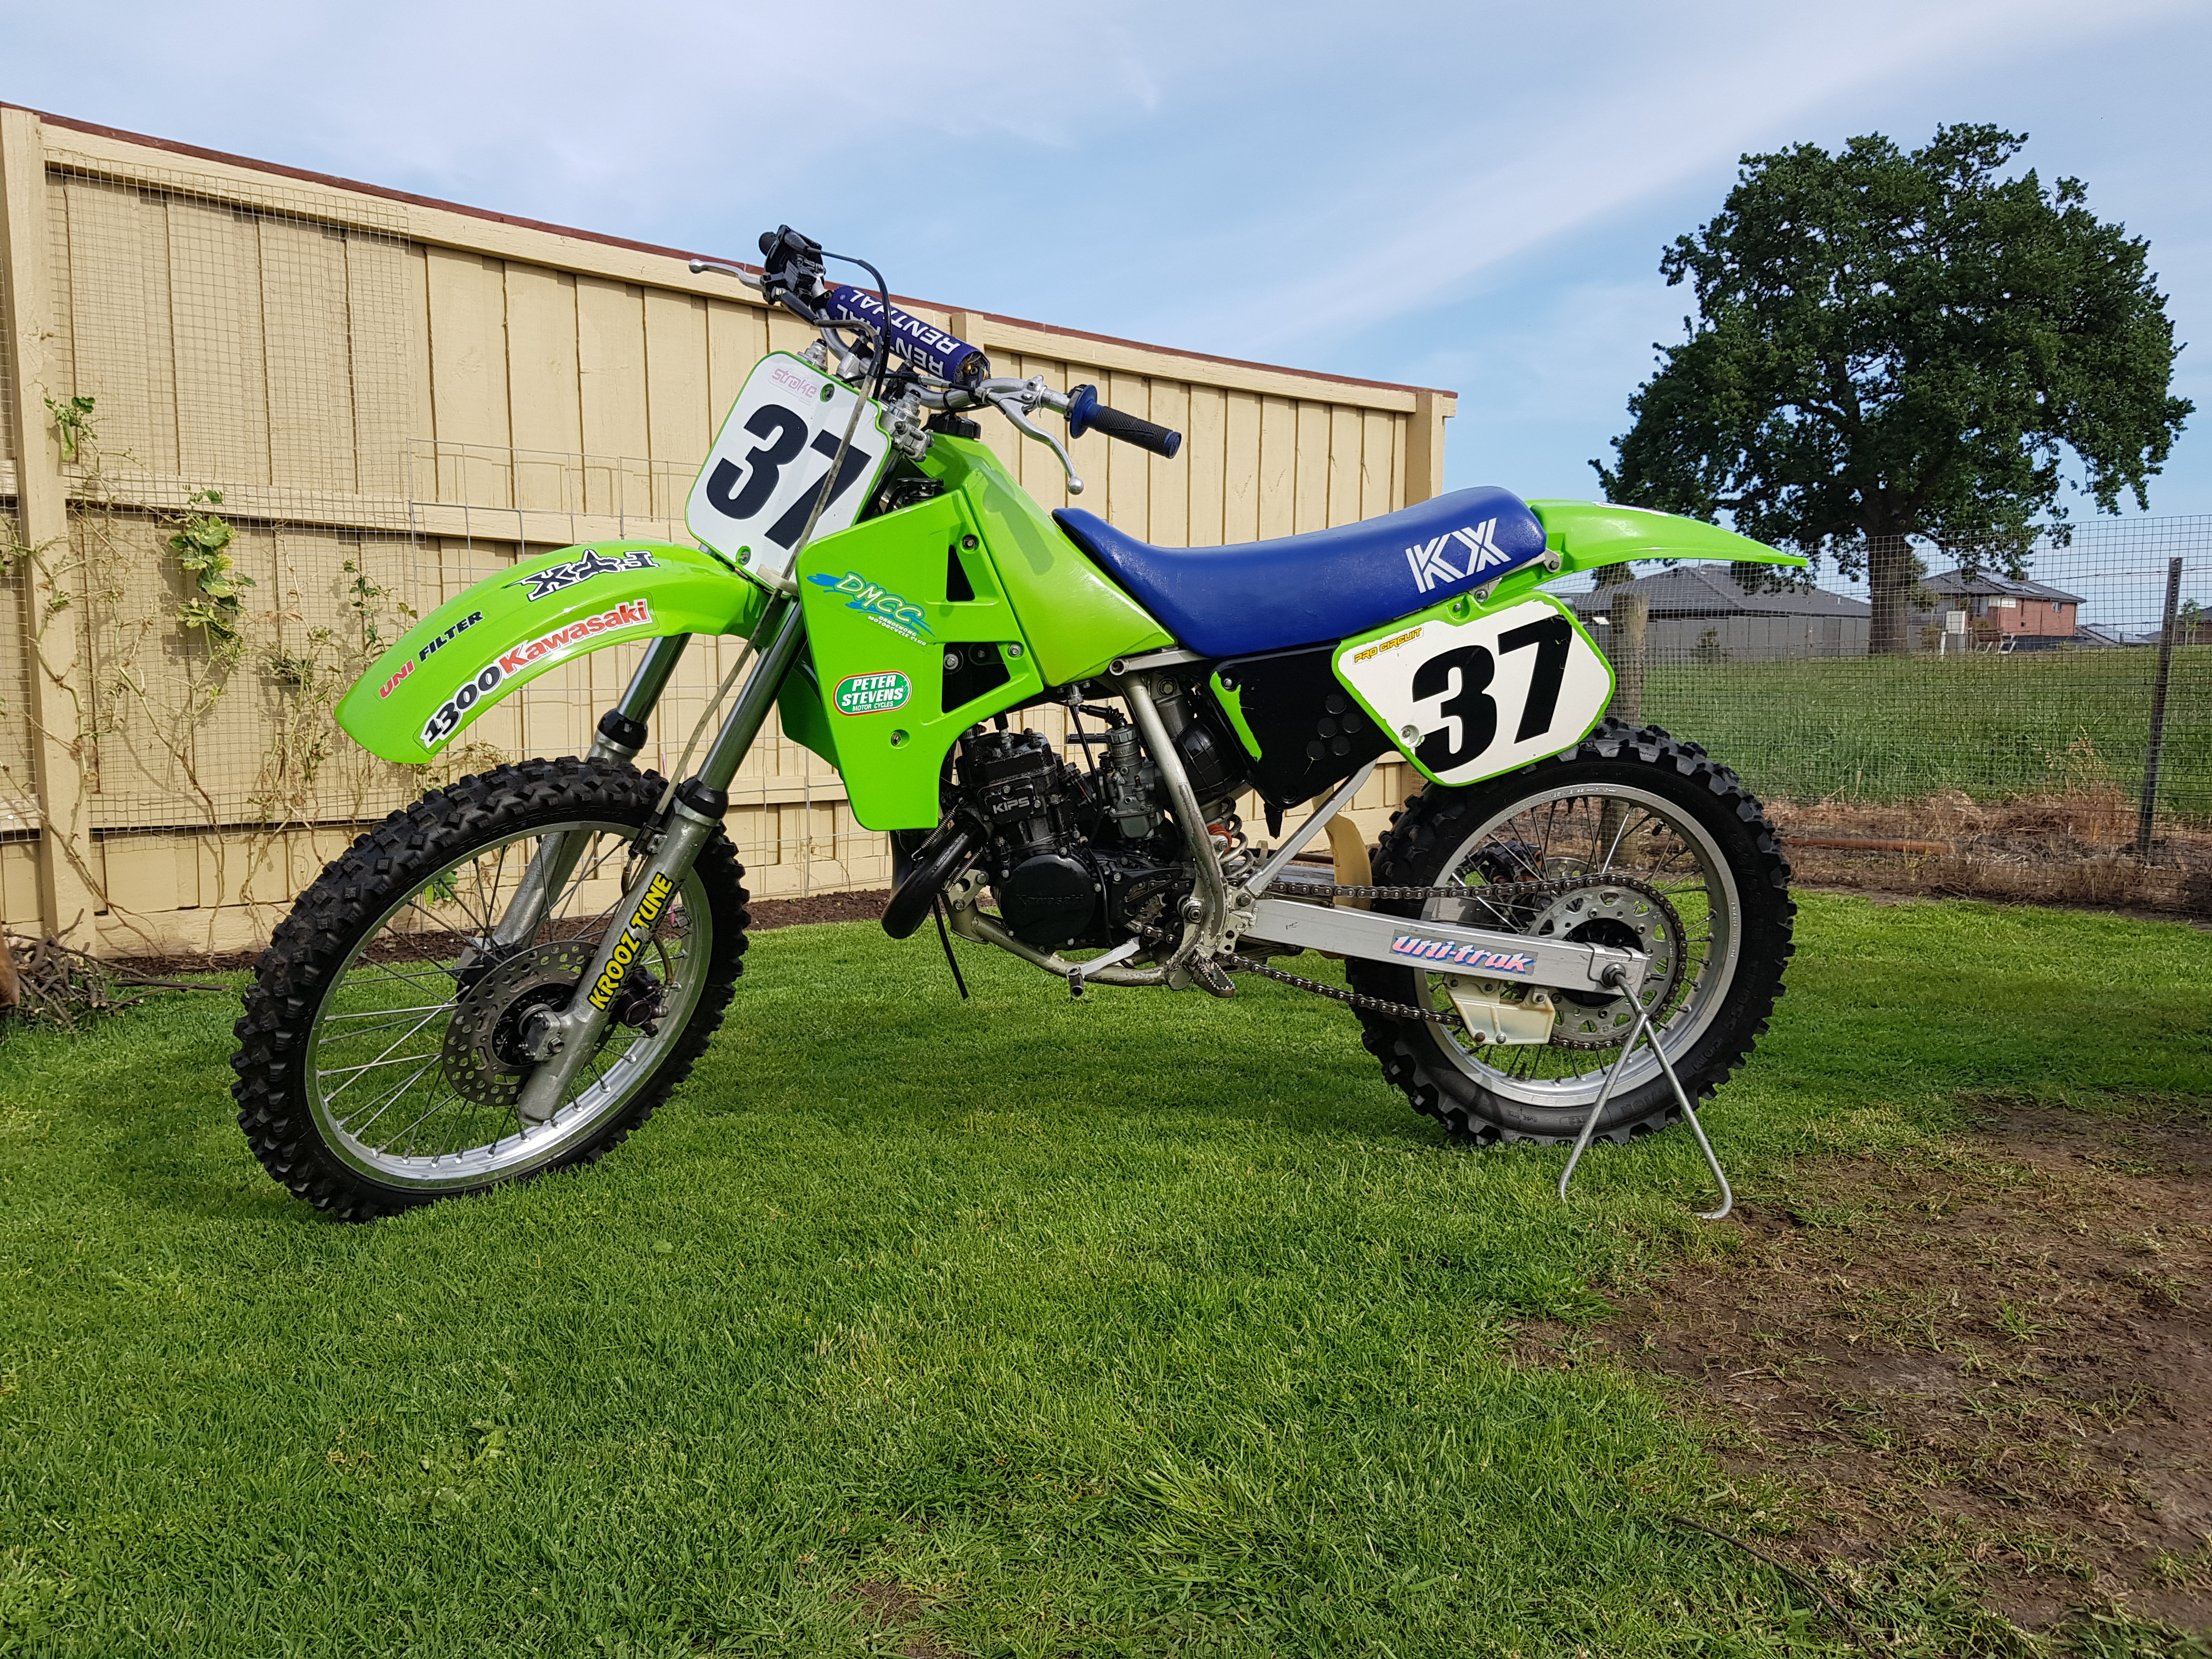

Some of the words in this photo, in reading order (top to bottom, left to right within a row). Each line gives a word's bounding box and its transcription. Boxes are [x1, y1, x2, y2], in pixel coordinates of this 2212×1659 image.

[706, 404, 872, 550] 37
[1405, 517, 1511, 594] KX
[837, 574, 922, 622] DMCC
[498, 600, 650, 675] Kawasaki
[867, 616, 910, 638] MOTORCYCLE
[910, 636, 927, 646] CLUB
[878, 616, 917, 637] DANDENONG
[1354, 646, 1378, 663] PRO
[1380, 627, 1422, 652] CIRCUIT
[379, 659, 414, 699] UNI
[419, 611, 484, 663] FILTER
[842, 687, 904, 707] STEVENS
[851, 675, 896, 692] PETER
[1412, 613, 1573, 774] 37
[852, 703, 872, 712] MOTOR
[874, 701, 894, 709] CYCLES
[992, 796, 1030, 814] KIPS
[588, 927, 642, 1012] KROOZ
[630, 872, 673, 930] TUNE
